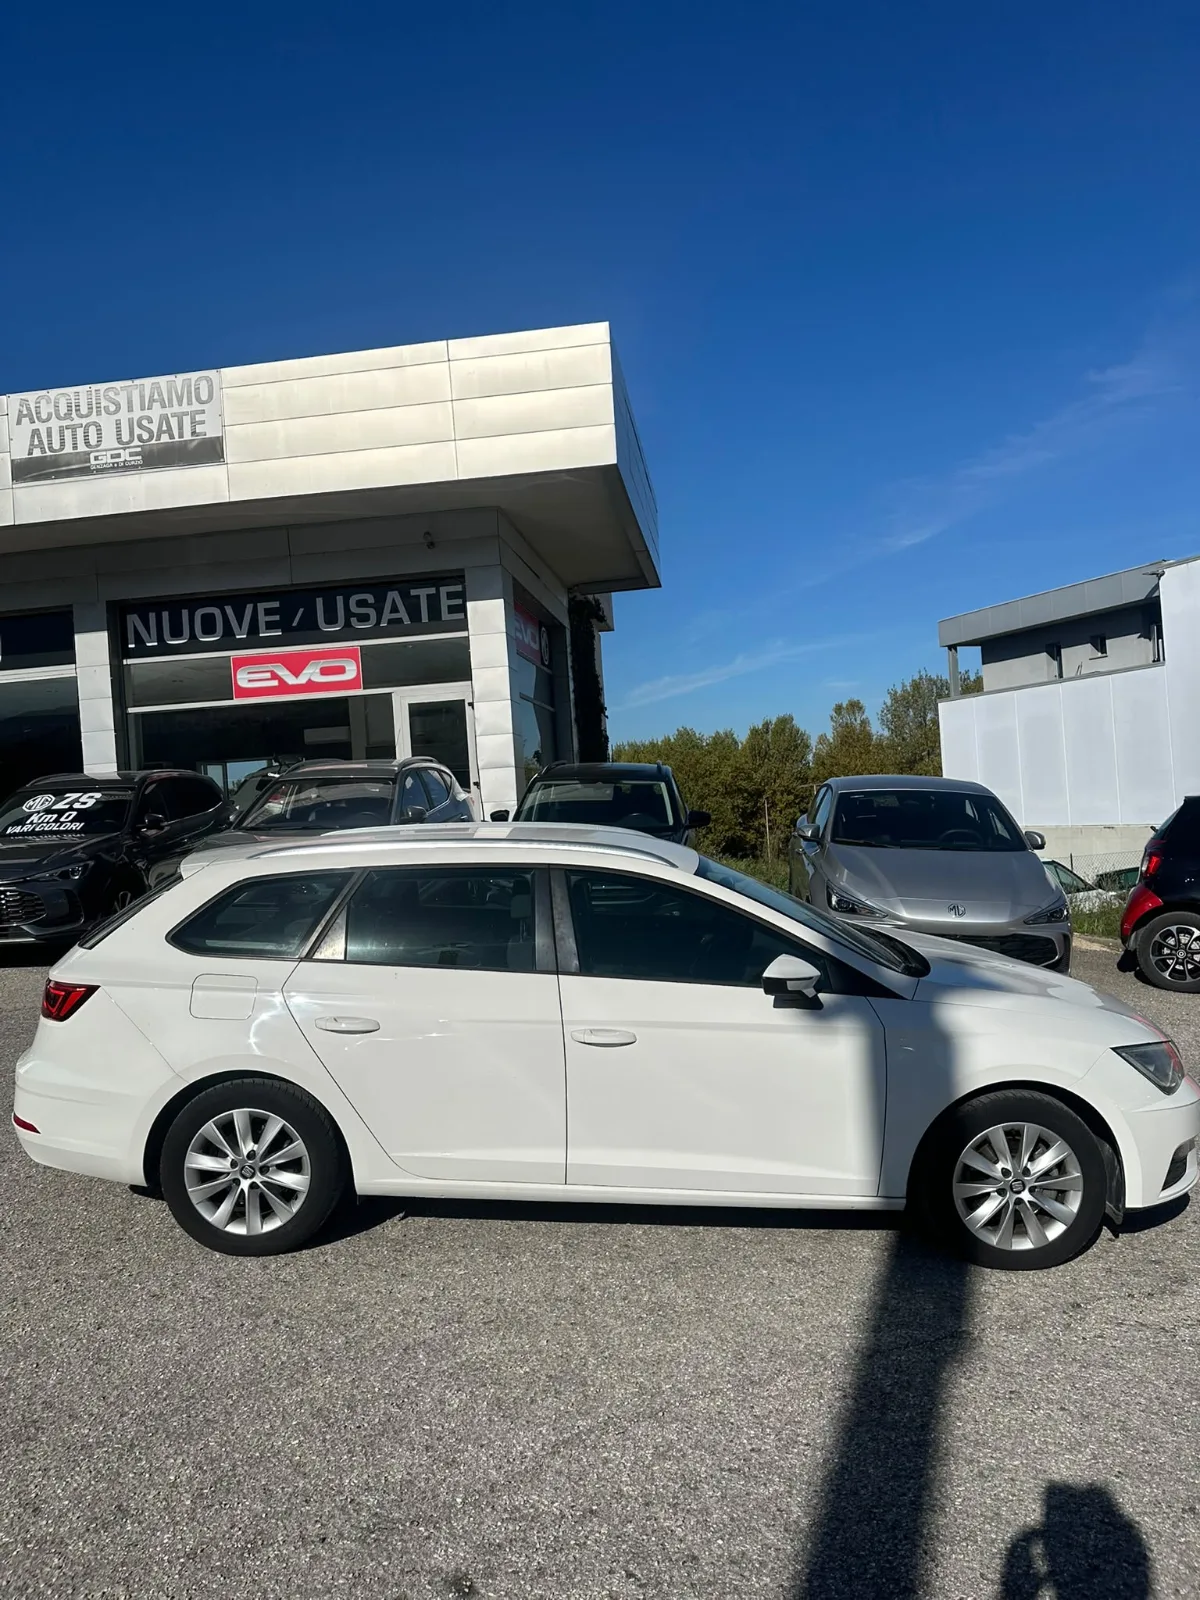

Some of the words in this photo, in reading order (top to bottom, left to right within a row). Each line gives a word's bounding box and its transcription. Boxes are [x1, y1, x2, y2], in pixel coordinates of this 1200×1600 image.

[16, 375, 214, 426] ACQUISTIAMO
[27, 421, 103, 456] AUTO
[115, 409, 207, 446] USATE
[90, 447, 142, 465] GDC
[126, 601, 282, 648] NUOVE
[316, 585, 465, 631] USATE
[236, 658, 358, 688] EVO
[23, 795, 55, 811] MG
[51, 793, 102, 809] ZS
[6, 824, 36, 834] VARI
[35, 822, 85, 831] COLORI
[26, 812, 58, 824] Km
